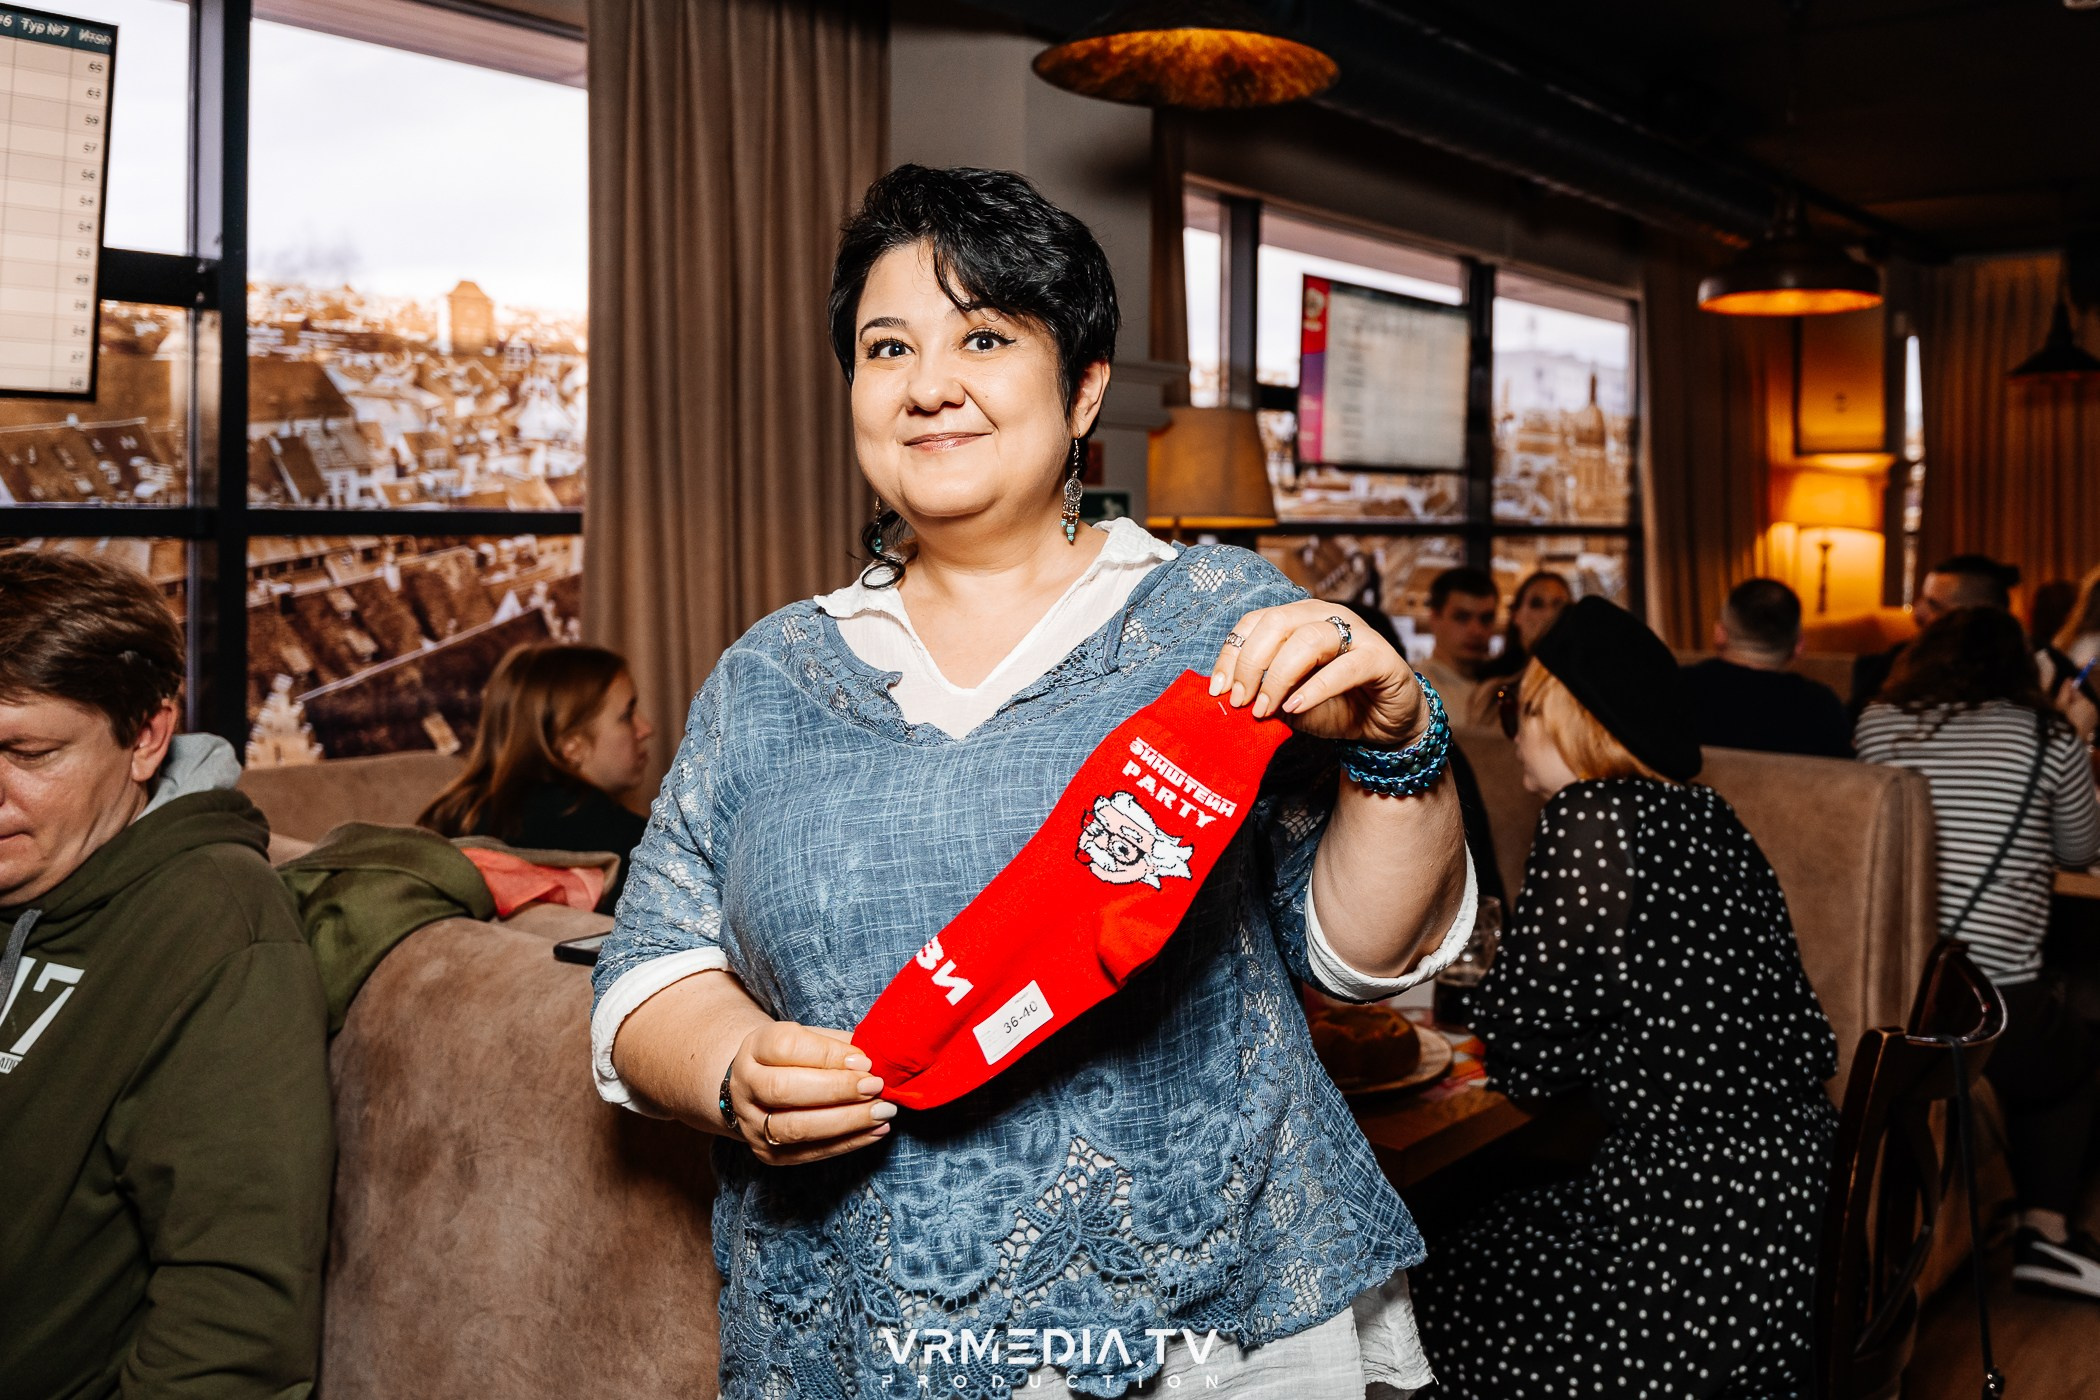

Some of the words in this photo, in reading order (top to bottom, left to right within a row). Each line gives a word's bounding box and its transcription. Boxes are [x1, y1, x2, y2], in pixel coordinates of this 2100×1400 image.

[21, 17, 46, 35] Тур
[83, 141, 98, 154] 57
[1122, 759, 1216, 828] PARTY
[1003, 1001, 1038, 1034] 36-40
